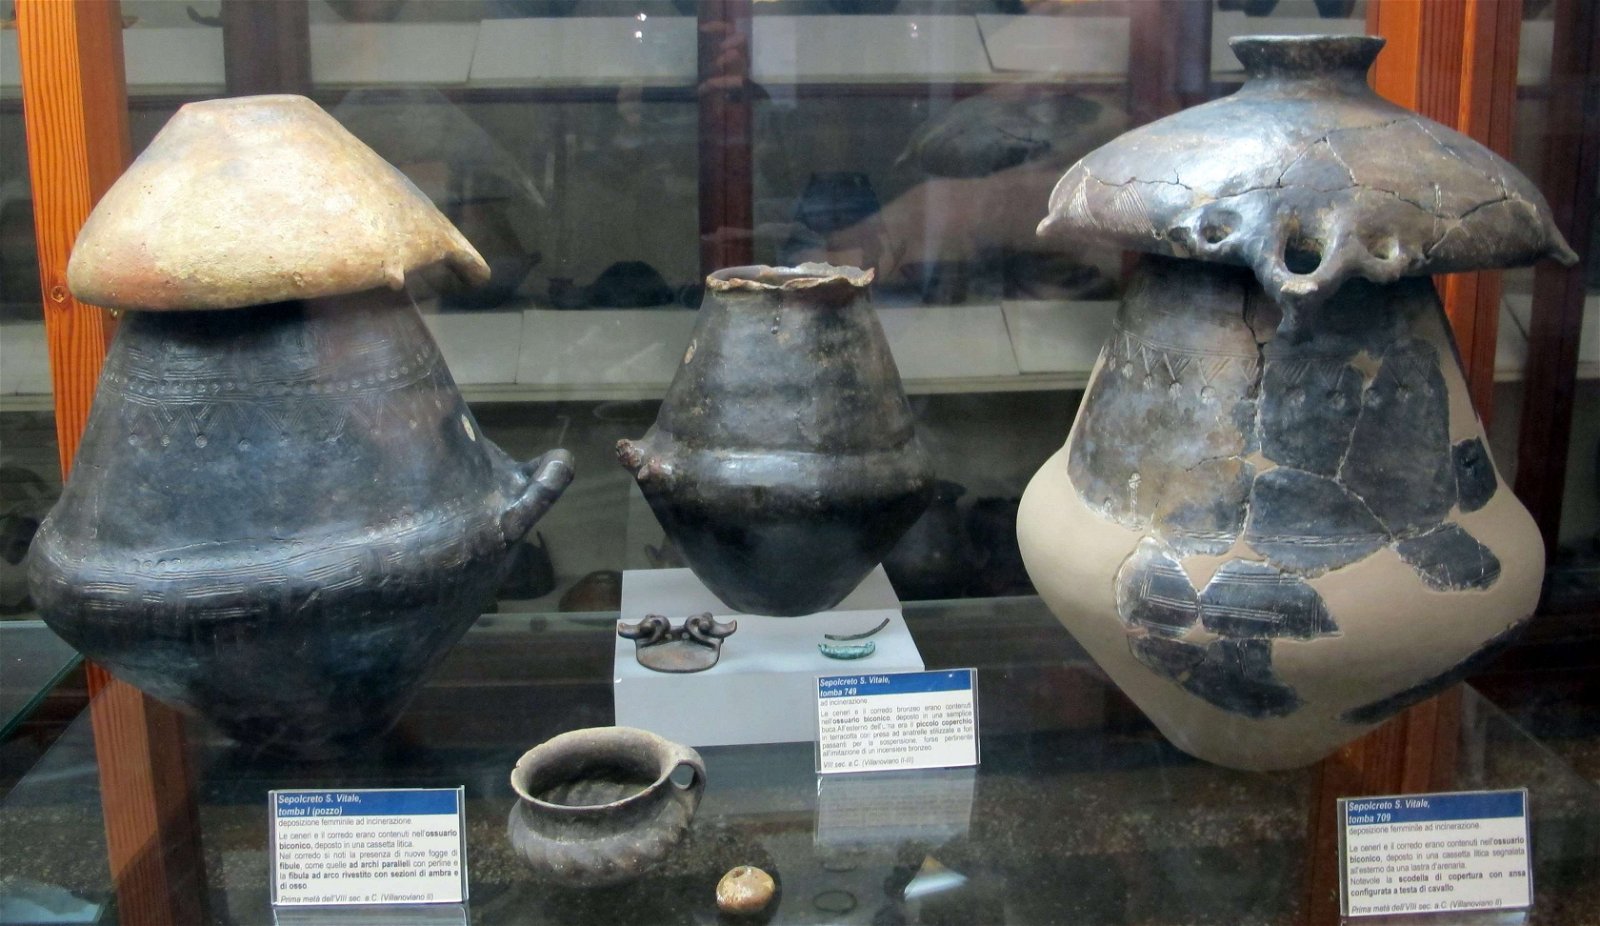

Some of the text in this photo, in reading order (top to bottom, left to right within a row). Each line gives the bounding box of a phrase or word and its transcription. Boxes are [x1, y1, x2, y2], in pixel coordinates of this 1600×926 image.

[820, 678, 857, 687] Sepolcreto
[869, 676, 890, 684] Vitale,
[916, 720, 939, 728] piccolo
[942, 718, 972, 726] coperchio
[279, 794, 323, 805] Sepolcreto
[337, 794, 361, 803] Vitale,
[1349, 798, 1430, 812] Sepolcreto S. Vitale,
[279, 807, 304, 816] tomba
[312, 806, 342, 816] (pozzo)
[279, 819, 319, 827] deposizione
[356, 817, 364, 825] ad
[1349, 813, 1391, 824] tomba 709
[412, 829, 457, 837] nell'ossuario
[1349, 826, 1389, 836] deposizione
[1391, 824, 1422, 833] femminile
[280, 842, 313, 850] biconico,
[315, 841, 342, 851] deposto
[1447, 839, 1477, 847] contenuti
[429, 850, 448, 858] fogge
[1350, 855, 1382, 863] biconico,
[1386, 853, 1413, 862] deposto
[1474, 849, 1489, 857] litica
[1493, 848, 1524, 857] segnalata
[280, 862, 302, 870] fibule,
[382, 860, 410, 869] paralleli
[1350, 877, 1380, 885] Notevole
[1399, 874, 1429, 882] scodella
[1448, 872, 1483, 881] copertura
[1351, 888, 1391, 897] configurata
[1428, 884, 1453, 892] cavallo
[381, 893, 425, 902] (Villanoviano
[1352, 906, 1371, 914] Prima
[1450, 899, 1493, 909] (Villanoviano
